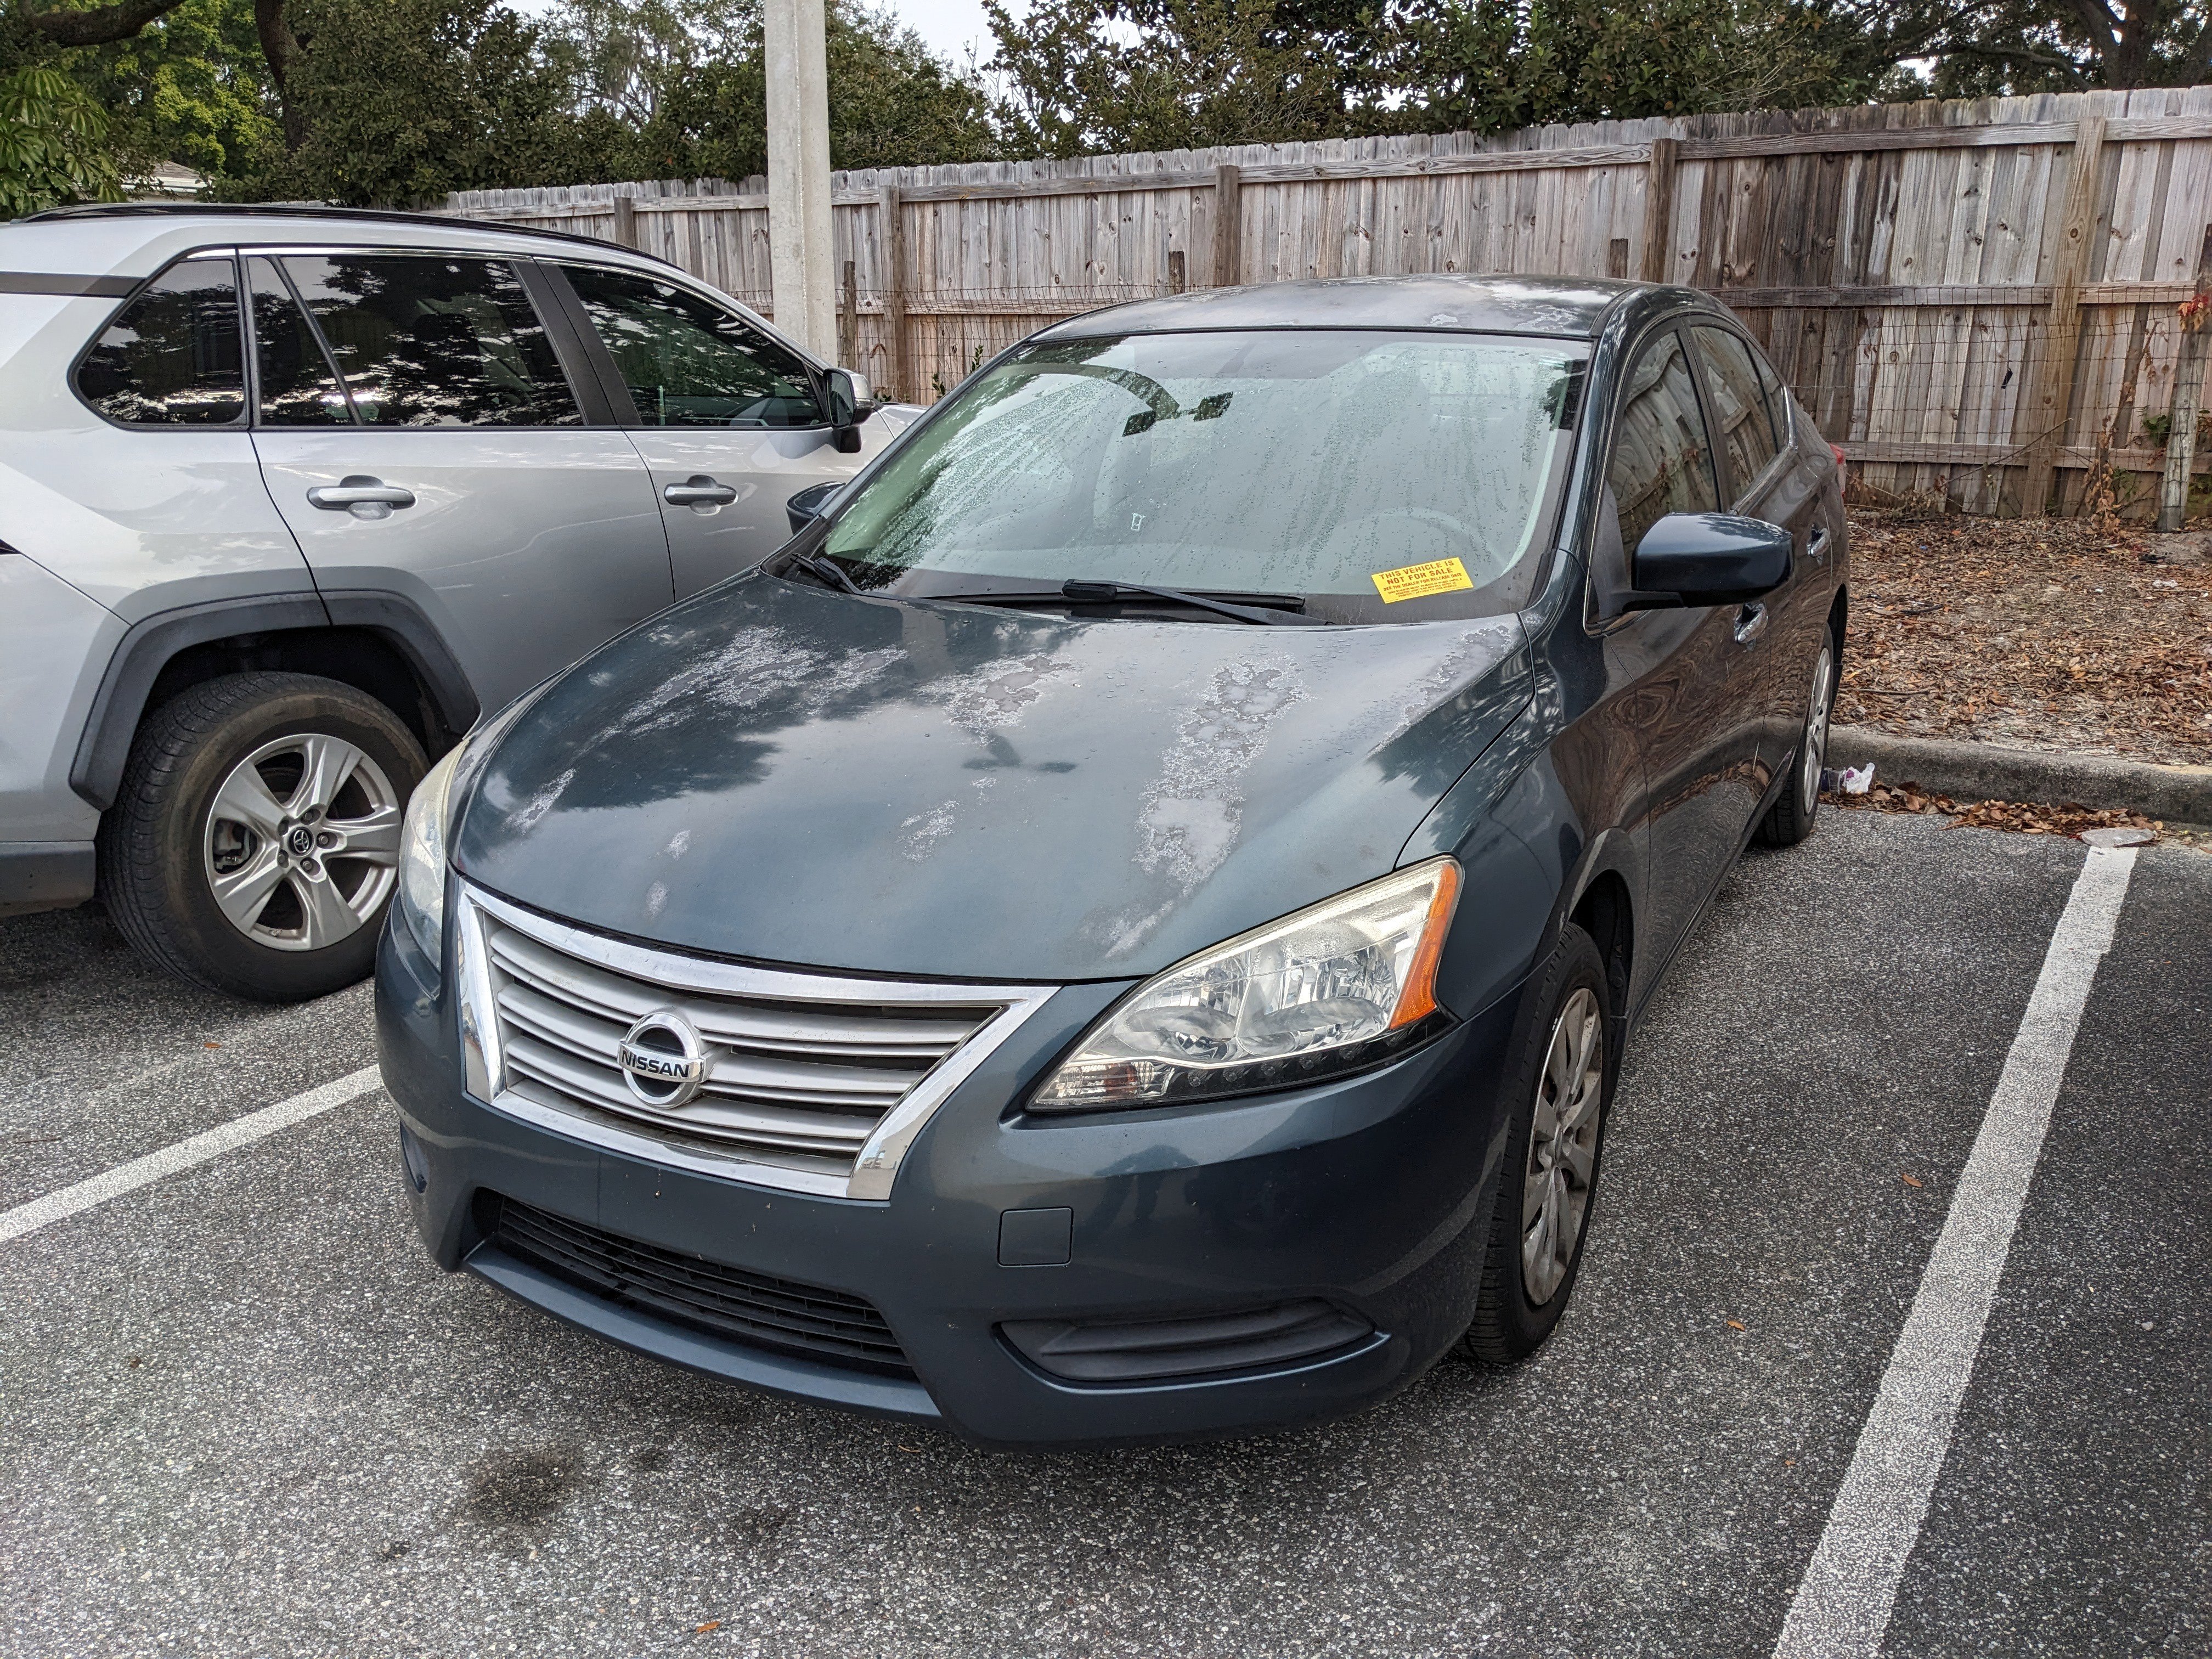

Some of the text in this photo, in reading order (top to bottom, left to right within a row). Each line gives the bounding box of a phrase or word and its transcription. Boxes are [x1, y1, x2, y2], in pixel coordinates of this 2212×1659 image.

[1379, 571, 1401, 580] THIS
[1403, 562, 1442, 574] VEHICLE
[1386, 567, 1453, 585] NOT FOR SALE
[622, 1050, 690, 1078] NISSAN
